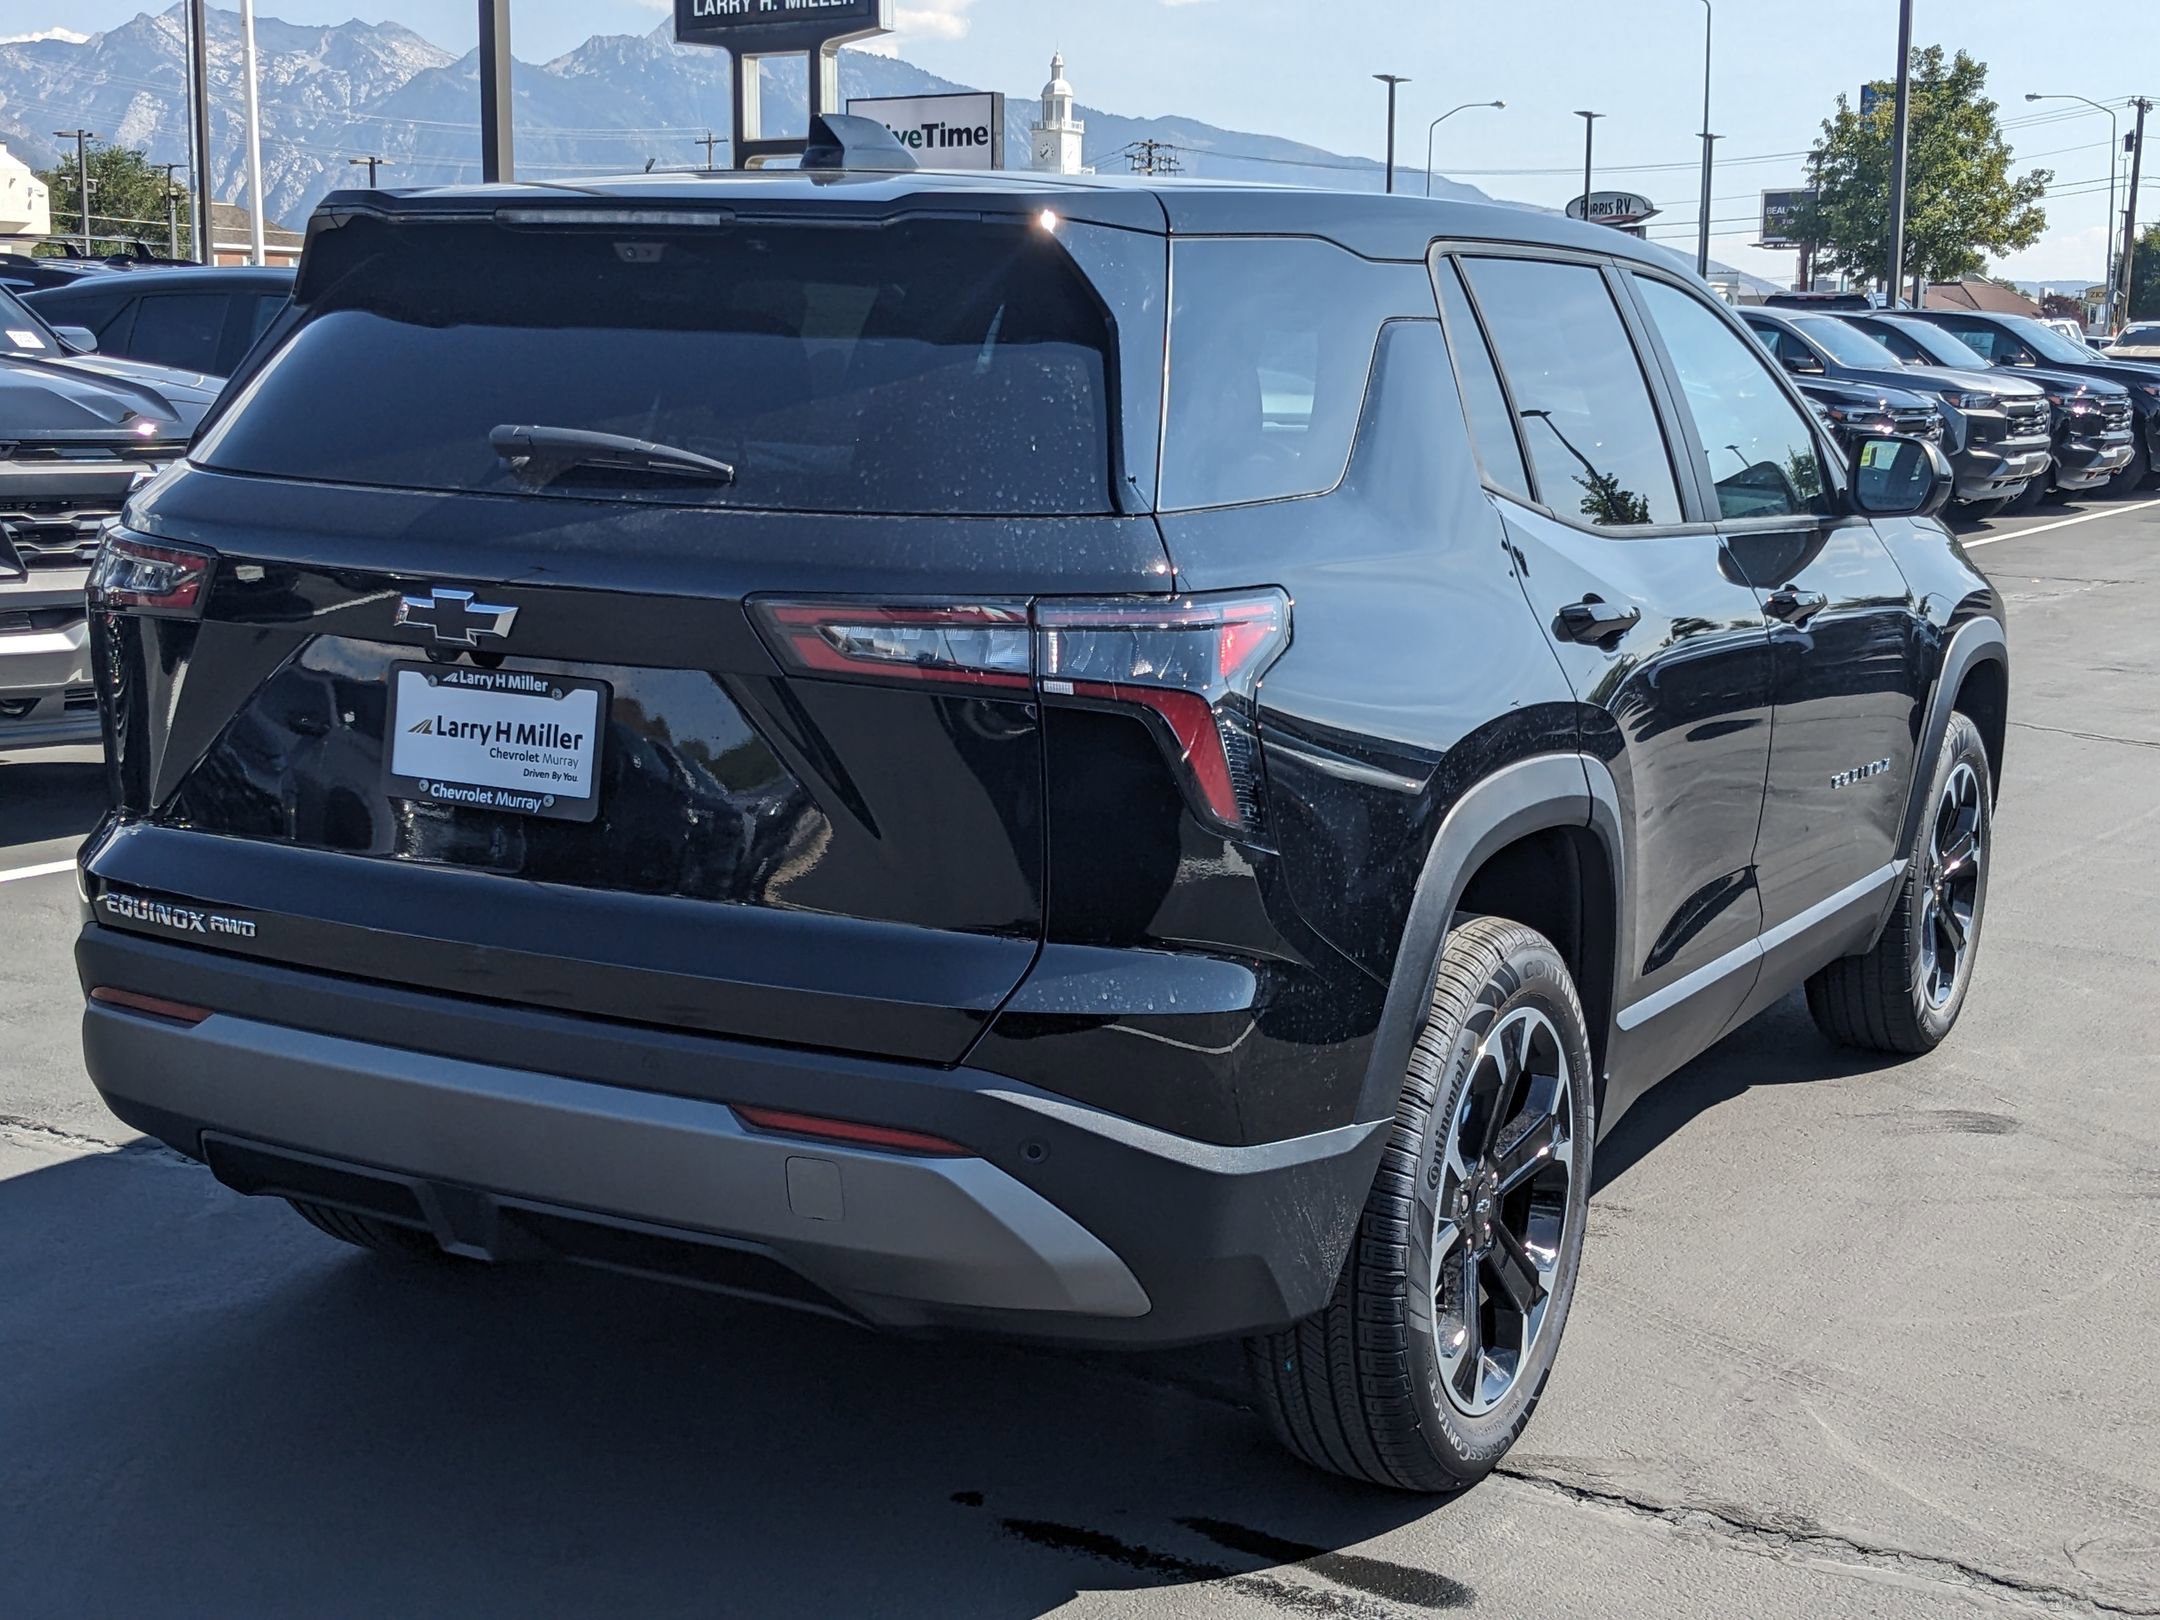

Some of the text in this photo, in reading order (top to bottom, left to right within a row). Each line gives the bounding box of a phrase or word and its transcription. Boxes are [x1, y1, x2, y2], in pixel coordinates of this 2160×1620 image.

[693, 0, 750, 17] LARRY
[885, 121, 989, 149] veTime
[1615, 198, 1632, 215] RV
[459, 670, 548, 692] Larry H Miller
[436, 715, 583, 751] Larry H Miller
[489, 748, 579, 769] Chevrolet Murray
[523, 768, 550, 780] Driven
[551, 771, 563, 782] By
[430, 783, 542, 813] Chevrolet Murray
[106, 893, 256, 937] EQUINOX AWD
[1427, 1061, 1466, 1191] Continental
